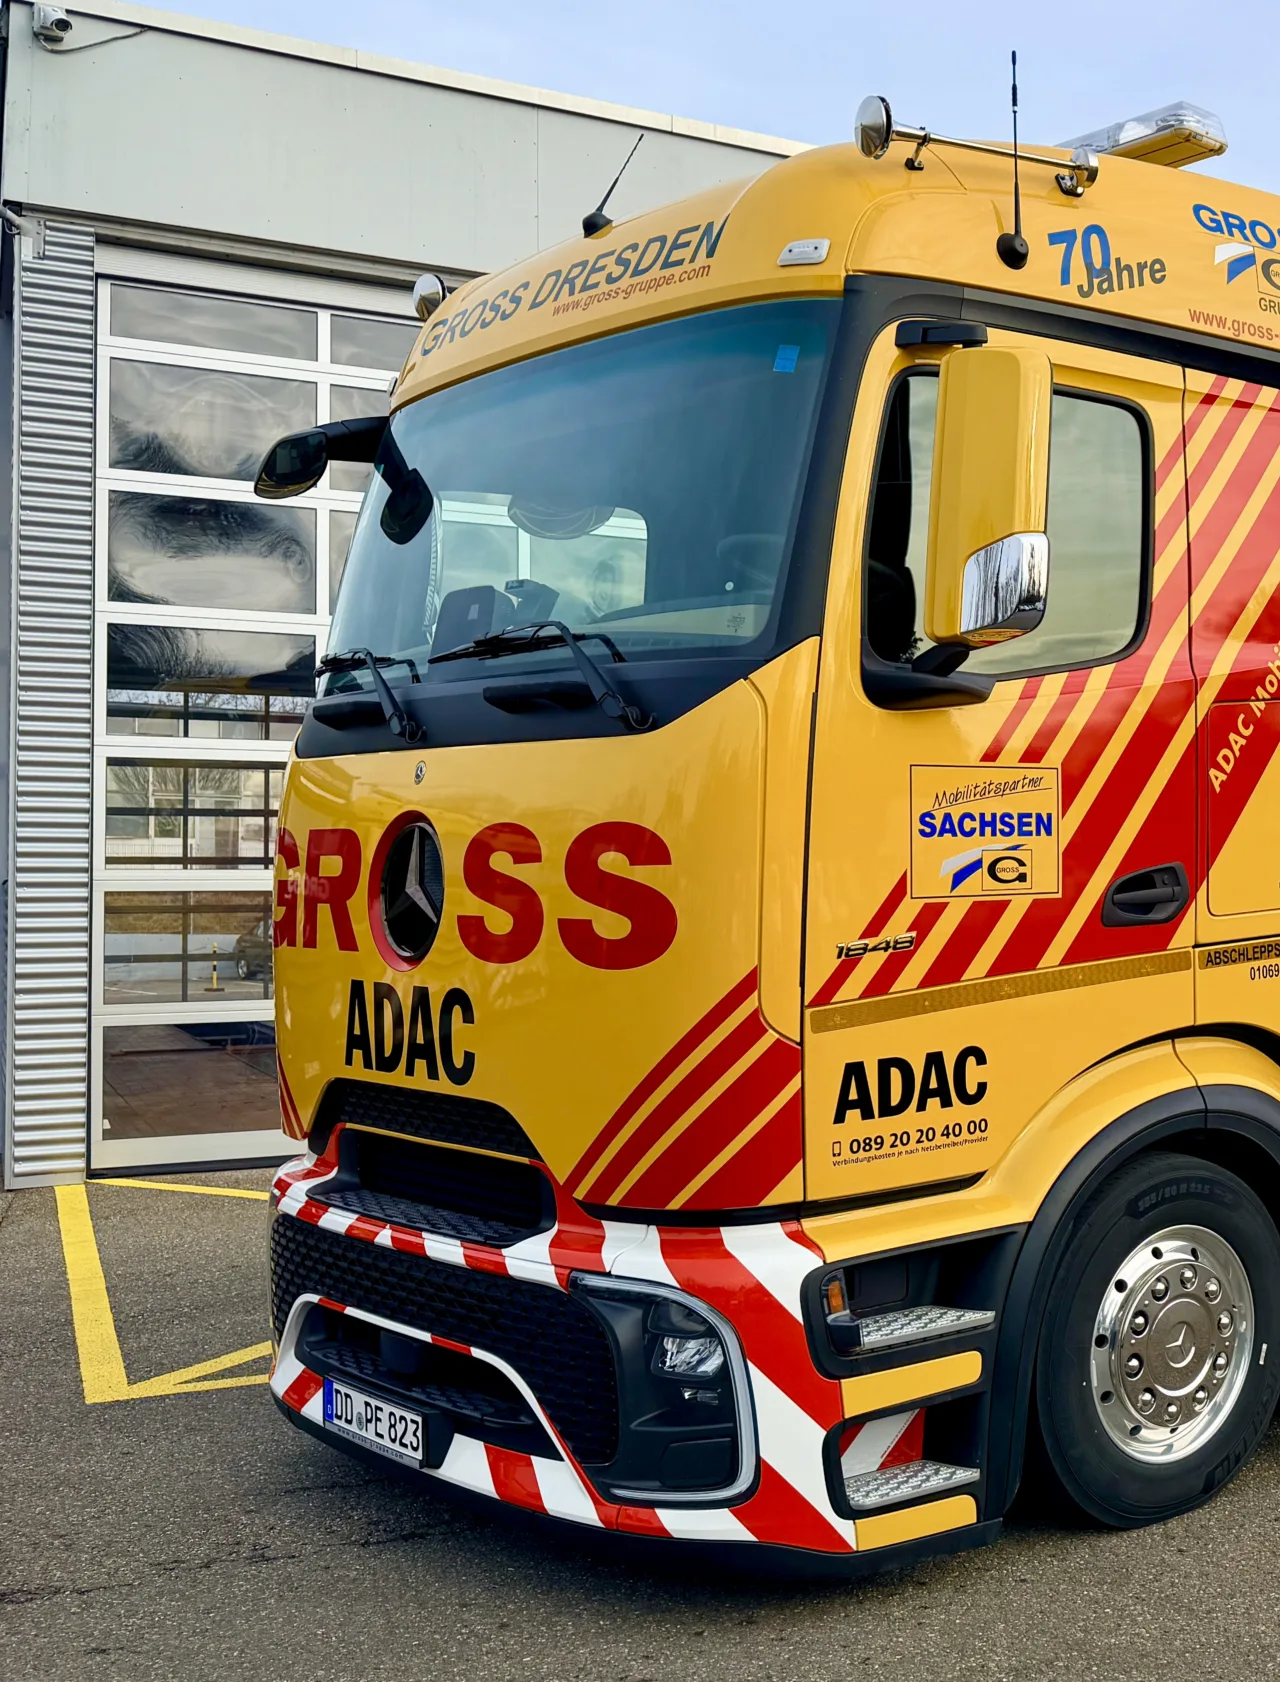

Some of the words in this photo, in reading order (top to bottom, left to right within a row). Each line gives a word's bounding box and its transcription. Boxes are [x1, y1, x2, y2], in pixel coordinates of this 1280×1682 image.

[1047, 224, 1111, 286] 70
[1077, 257, 1167, 298] Jahre
[420, 281, 531, 357] GROSS
[528, 213, 731, 312] DRESDEN
[551, 264, 711, 317] www.gross-gruppe.com
[1208, 698, 1254, 794] ADAC
[932, 774, 1044, 809] Mobilitätspartner
[918, 812, 1053, 838] SACHSEN
[273, 811, 678, 970] GROSS
[996, 866, 1020, 874] GROSS
[836, 931, 917, 960] 1848
[1250, 963, 1280, 981] 01069
[345, 979, 476, 1087] ADAC
[833, 1045, 988, 1125] ADAC
[832, 1151, 896, 1167] Verbindungskosten
[904, 1147, 920, 1156] nach
[849, 1135, 885, 1154] 089
[889, 1130, 911, 1149] 20
[915, 1126, 936, 1144] 20
[940, 1122, 963, 1139] 40
[966, 1118, 989, 1135] 00
[334, 1388, 353, 1425] DD
[363, 1400, 385, 1440] PE
[388, 1411, 420, 1452] 823
